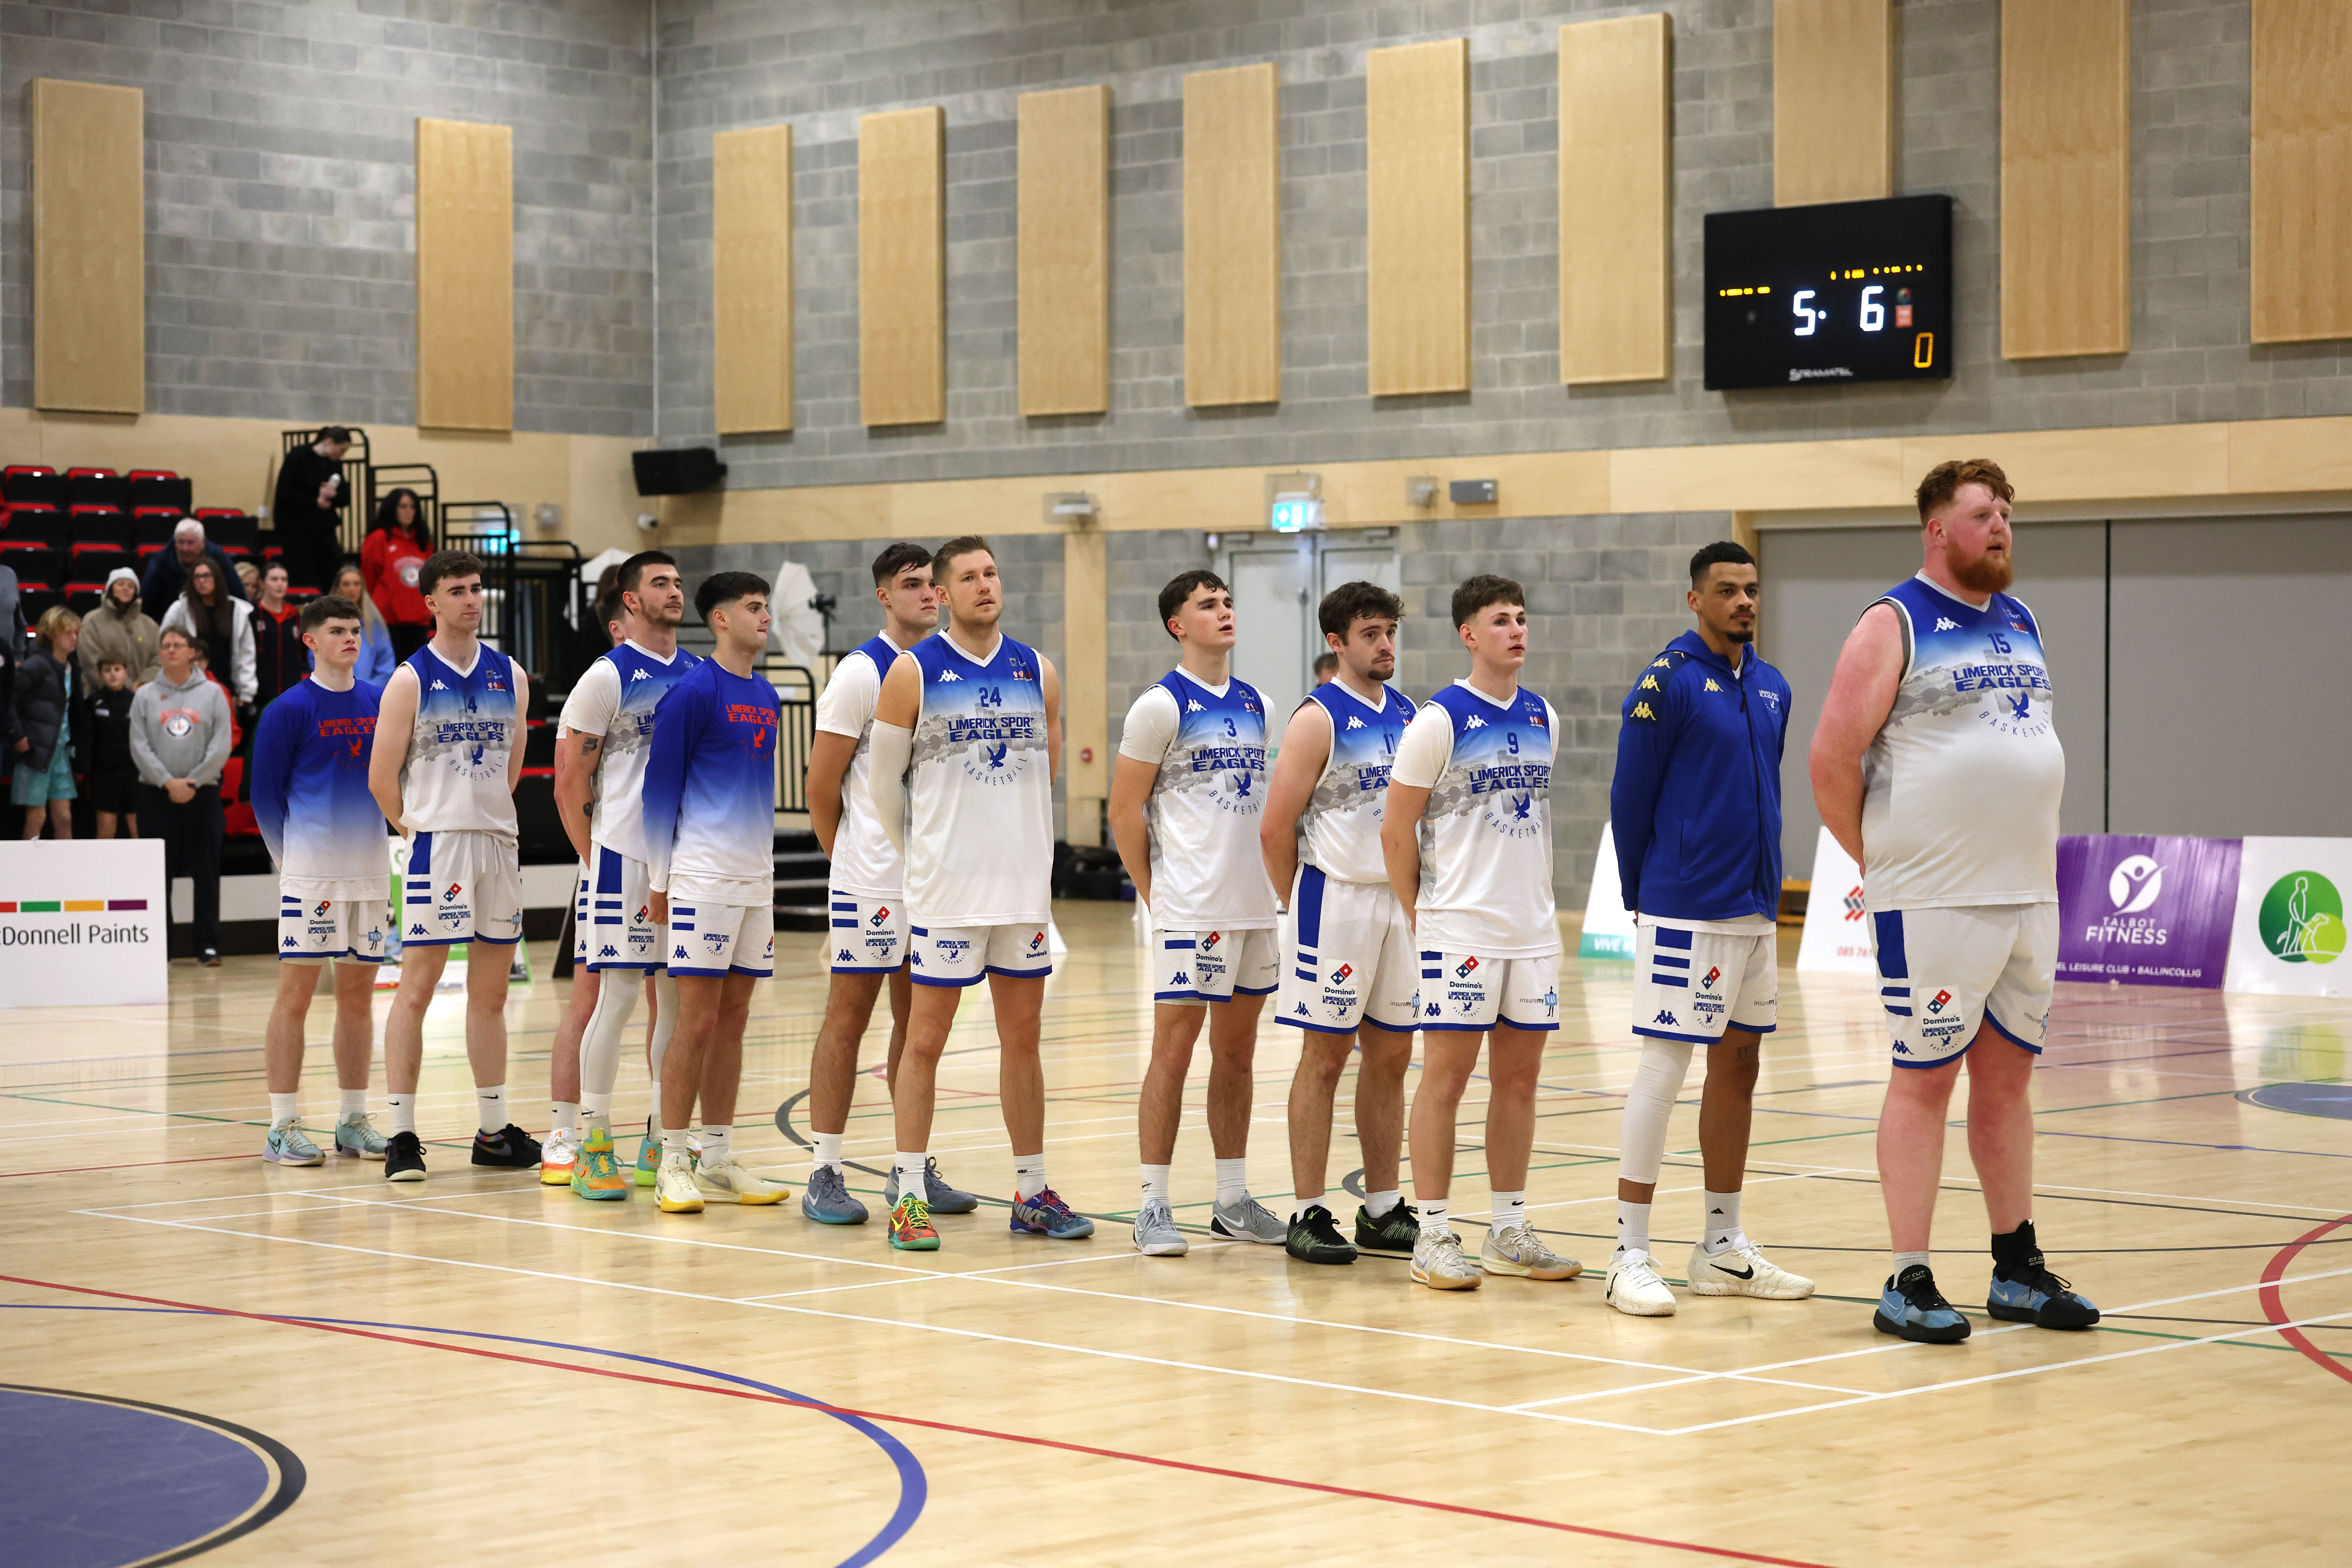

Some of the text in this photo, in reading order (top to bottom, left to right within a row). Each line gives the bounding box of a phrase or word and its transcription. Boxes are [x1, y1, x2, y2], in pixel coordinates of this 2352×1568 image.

[1859, 285, 1884, 332] 6
[1914, 332, 1933, 368] 0
[1987, 633, 2012, 654] 15
[1953, 664, 2047, 681] LIMERICK SPORT
[1955, 677, 2052, 692] EAGLES
[463, 695, 477, 713] 14
[979, 687, 1002, 708] 24
[726, 704, 758, 715] LIMERICK
[318, 718, 354, 729] LIMERICK
[728, 713, 778, 729] EAGLES
[948, 718, 997, 731] LIMERICK
[1223, 717, 1237, 737] 3
[1979, 710, 2049, 737] BASKETBALL
[319, 725, 376, 737] EAGLE
[438, 731, 504, 743] EAGLES
[950, 728, 1034, 742] EAGLES
[1383, 733, 1396, 754] 11
[1507, 732, 1519, 754] 9
[1192, 748, 1265, 761] LIMERICK SPORT
[964, 758, 1027, 786] BASKETBALL
[1193, 758, 1265, 772] EAGLES
[1358, 765, 1392, 780] LIMERIC
[1470, 765, 1522, 782] LIMERICK
[1485, 809, 1543, 838] BASKETBAL
[2103, 916, 2155, 928] TALBOT
[0, 922, 149, 946] Donnell Paints
[2085, 925, 2168, 946] FITNESS
[1027, 950, 1047, 958] Domino's
[1196, 953, 1223, 962] Domino's
[2069, 962, 2105, 973] LEISURE
[2105, 964, 2130, 975] CLUB
[2137, 965, 2202, 978] BALLINCOLLIG
[1325, 987, 1355, 995] Domino's
[1695, 992, 1722, 1001] Domino's
[1923, 1015, 1960, 1024] Domino's
[1923, 1028, 1965, 1037] EAGLES
